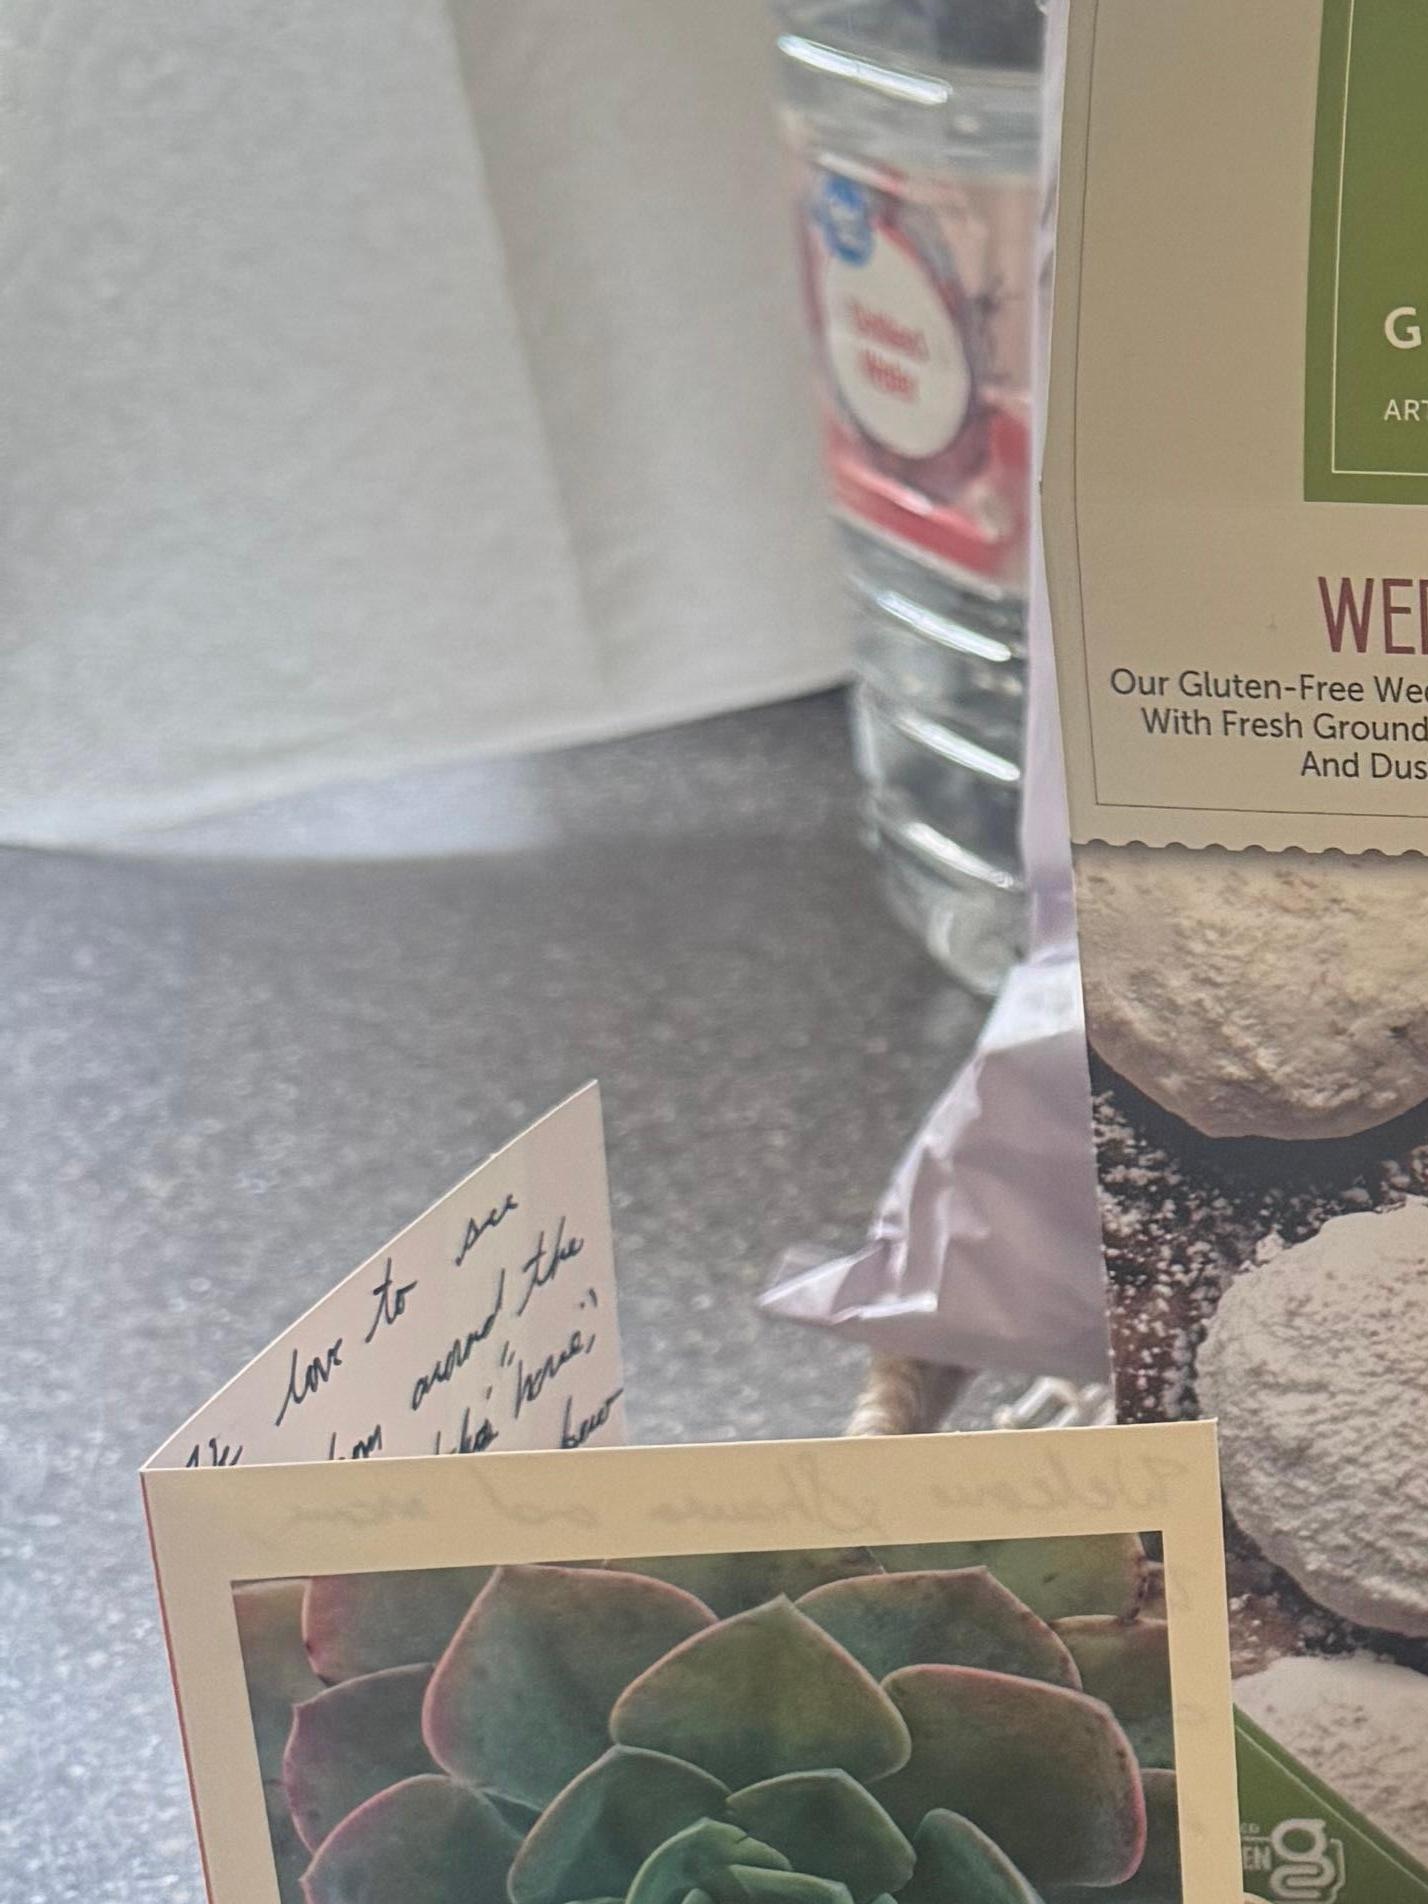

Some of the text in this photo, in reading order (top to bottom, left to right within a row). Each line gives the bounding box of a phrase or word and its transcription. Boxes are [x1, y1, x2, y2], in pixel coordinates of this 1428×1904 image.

[1110, 668, 1170, 697] Our
[1179, 669, 1365, 703] Gluten-Free
[1141, 706, 1211, 736] With
[1222, 709, 1303, 739] Fresh
[1313, 712, 1428, 742] Ground
[1300, 750, 1360, 779] And
[517, 1215, 585, 1317] the
[365, 1257, 417, 1344] to
